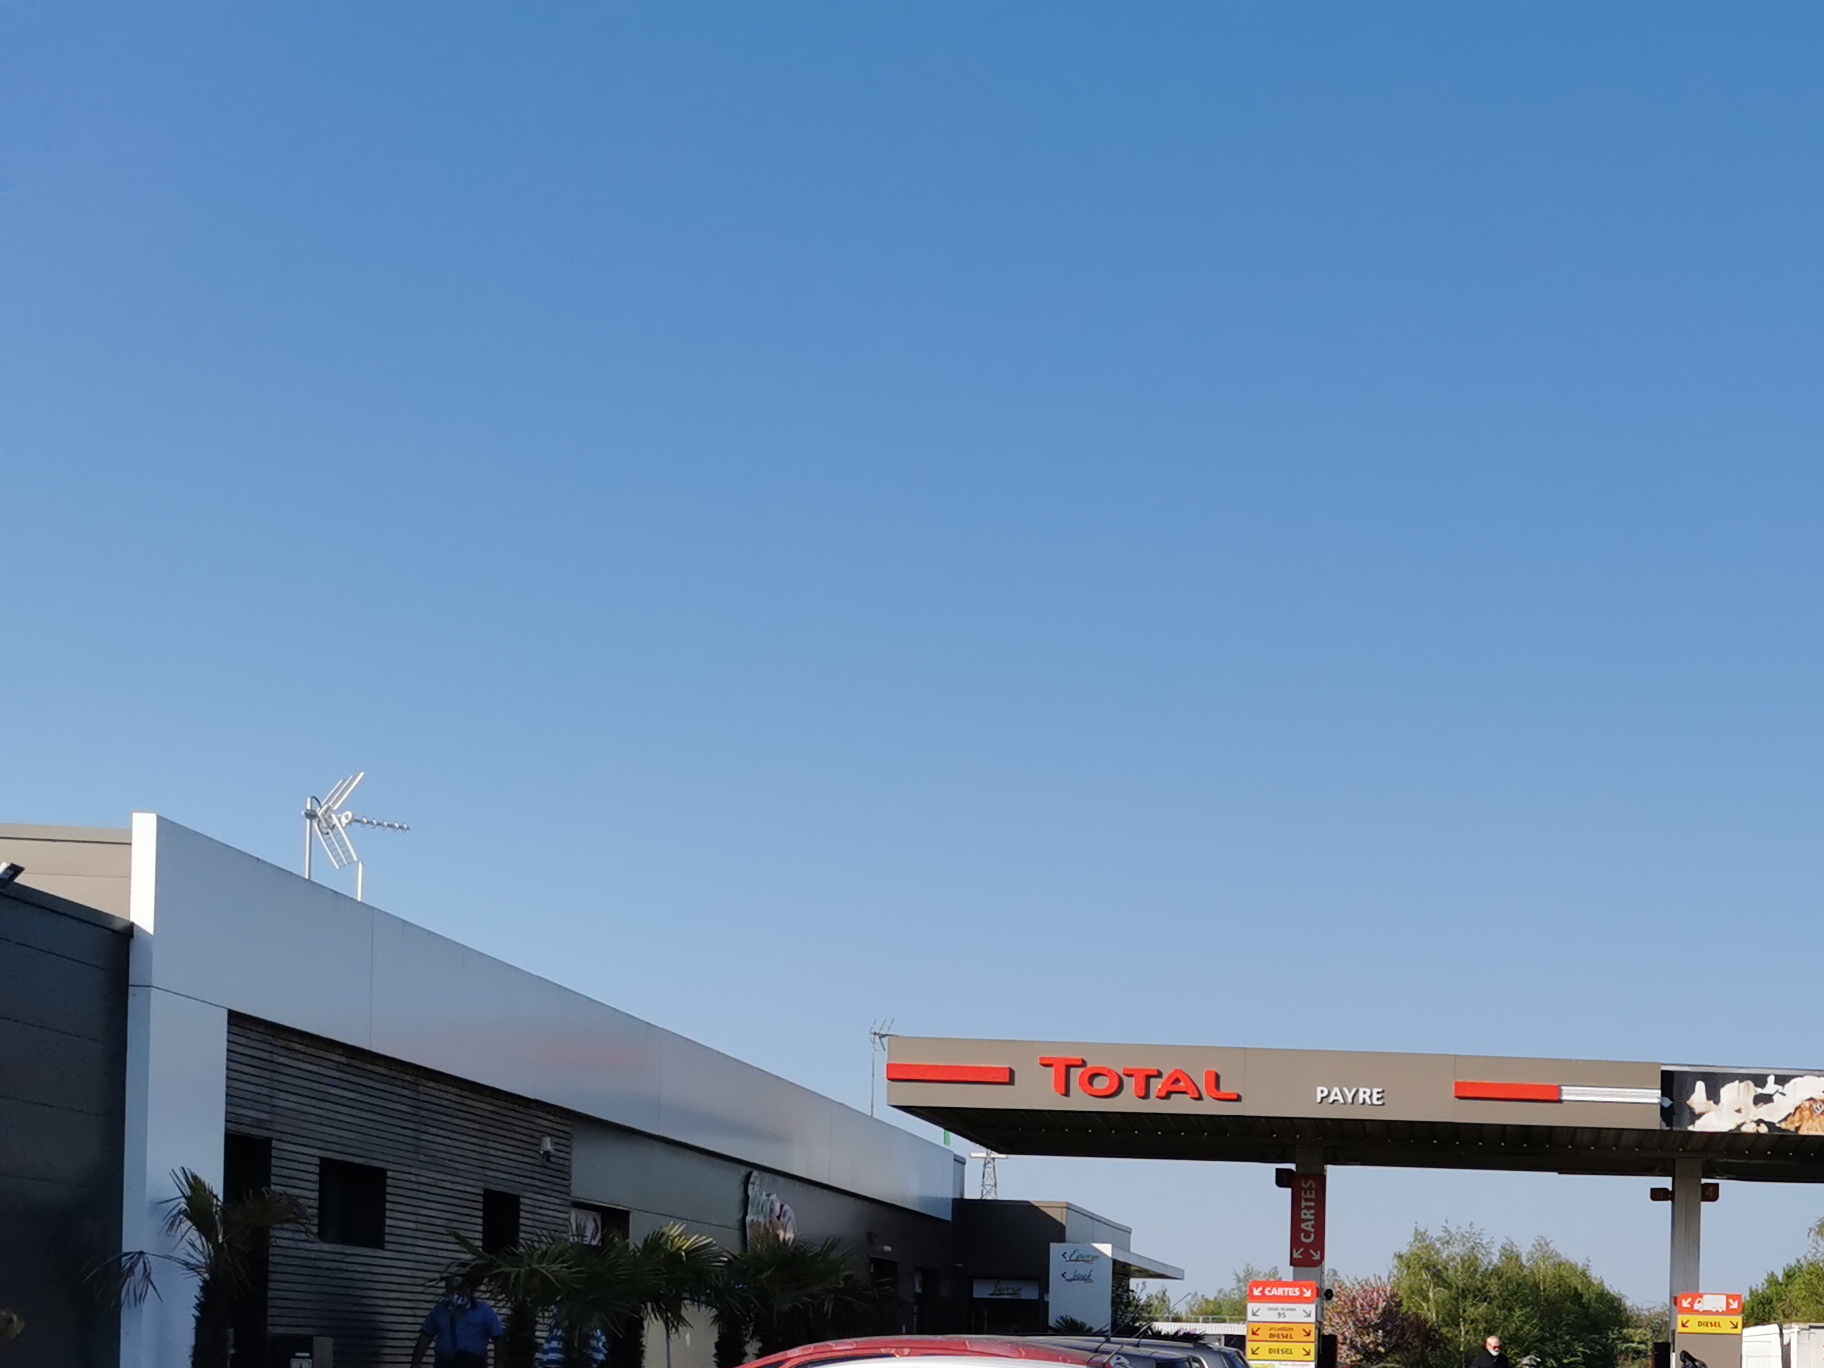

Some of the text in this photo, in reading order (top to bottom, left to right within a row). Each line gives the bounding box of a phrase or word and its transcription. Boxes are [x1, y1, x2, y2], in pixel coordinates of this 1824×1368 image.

[1039, 1056, 1242, 1102] TOTAL
[1316, 1086, 1385, 1106] PAYRE
[1301, 1179, 1316, 1244] CARTES
[1264, 1287, 1300, 1296] CARTES
[1697, 1320, 1722, 1328] DIESEL
[1268, 1332, 1294, 1340] DIESEL
[1268, 1347, 1294, 1355] DIESEL
